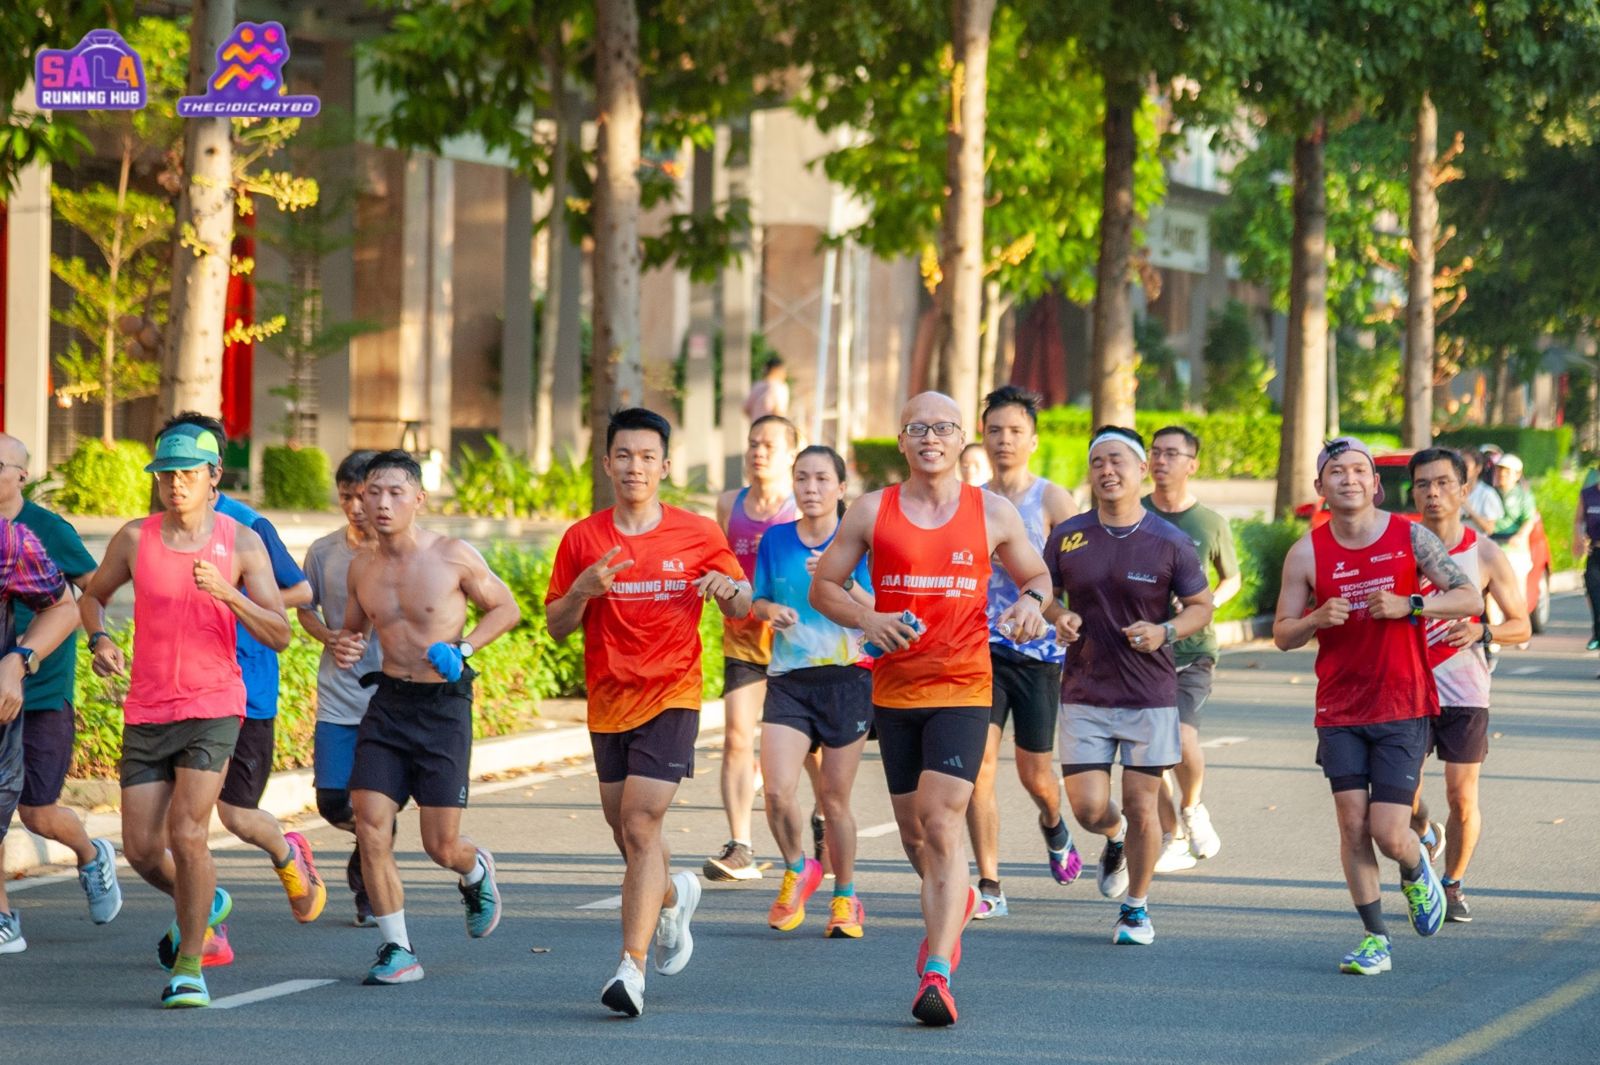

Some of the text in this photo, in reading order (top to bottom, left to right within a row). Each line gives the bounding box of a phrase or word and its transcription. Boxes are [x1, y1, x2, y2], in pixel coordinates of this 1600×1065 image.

[1061, 532, 1089, 553] 42
[664, 580, 686, 592] HUB
[903, 576, 954, 588] RUNNING
[1340, 576, 1394, 592] TECHCOMBANK
